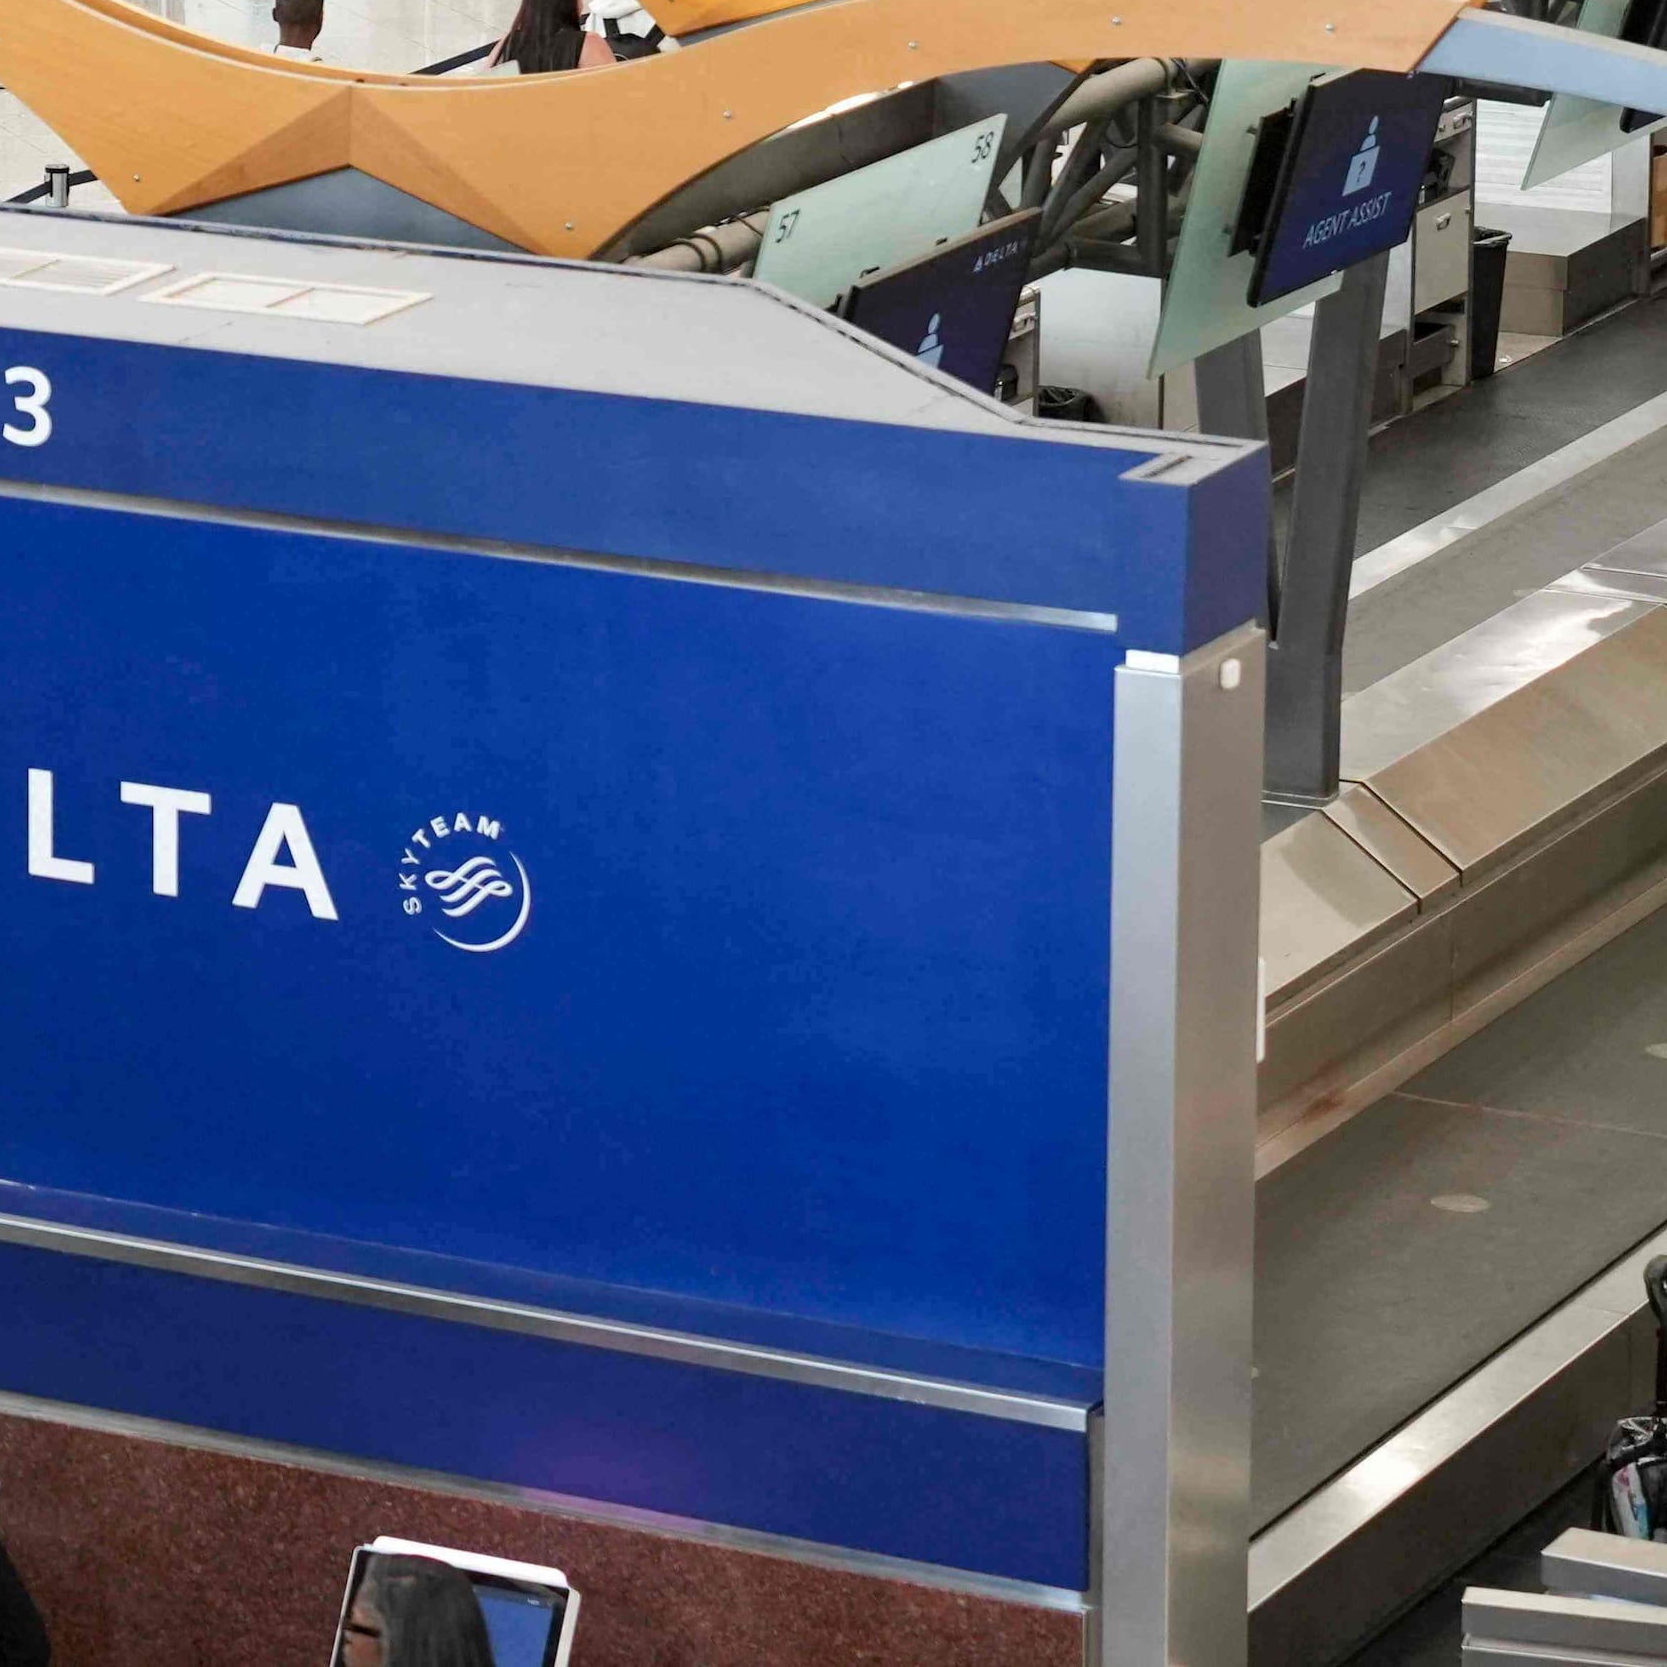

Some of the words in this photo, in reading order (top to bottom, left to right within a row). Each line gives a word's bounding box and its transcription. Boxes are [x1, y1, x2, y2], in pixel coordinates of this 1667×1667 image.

[971, 131, 994, 163] 58
[776, 208, 801, 243] 57
[1303, 210, 1350, 250] AGENT
[1348, 192, 1392, 232] ASSIST
[984, 240, 1019, 267] DELTA
[1, 365, 53, 446] 3
[403, 811, 504, 915] SKYTEAM
